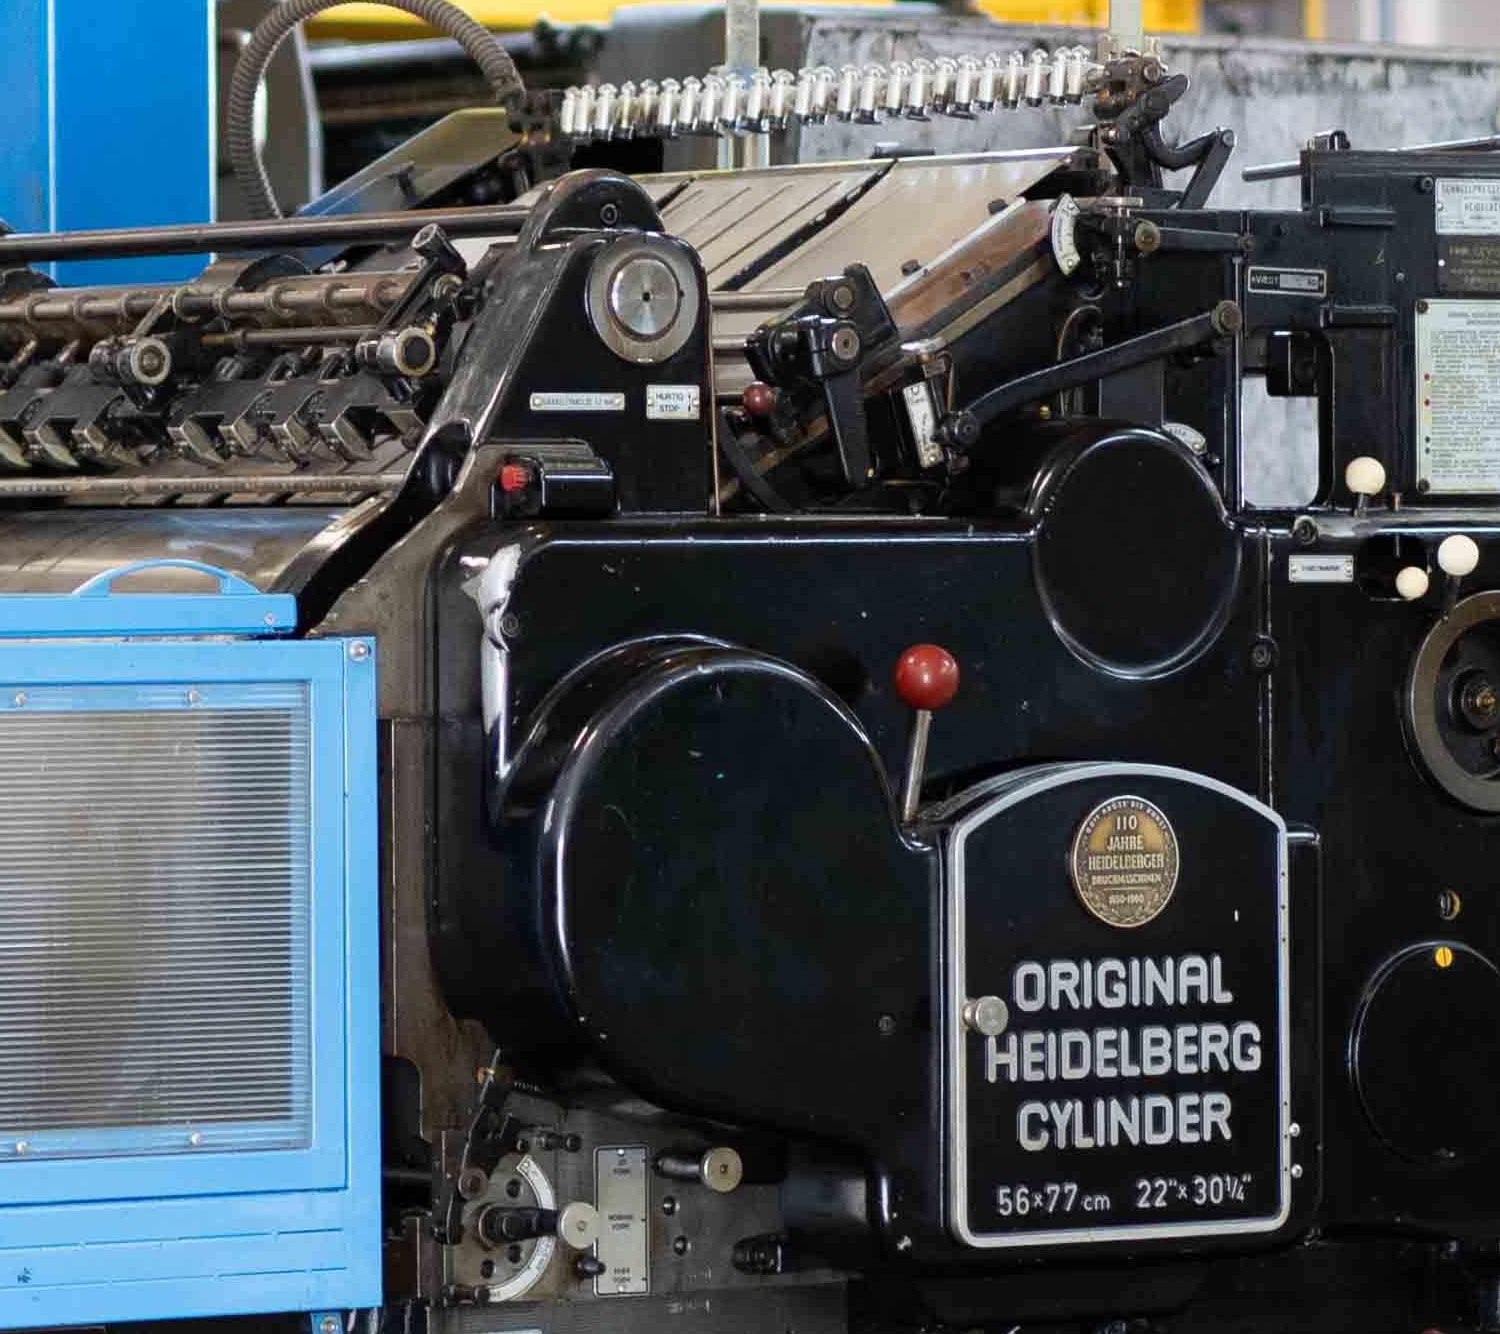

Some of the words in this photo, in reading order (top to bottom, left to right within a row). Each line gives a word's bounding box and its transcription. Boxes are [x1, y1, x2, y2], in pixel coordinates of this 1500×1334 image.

[1115, 814, 1138, 830] 110
[1106, 834, 1145, 851] JAHRE
[1088, 853, 1165, 870] HEIDELBERGER
[1014, 954, 1233, 1012] ORIGINAL
[986, 1021, 1261, 1084] HEIDELBERG
[1017, 1092, 1232, 1152] CYLINDER
[1081, 1194, 1111, 1212] cm
